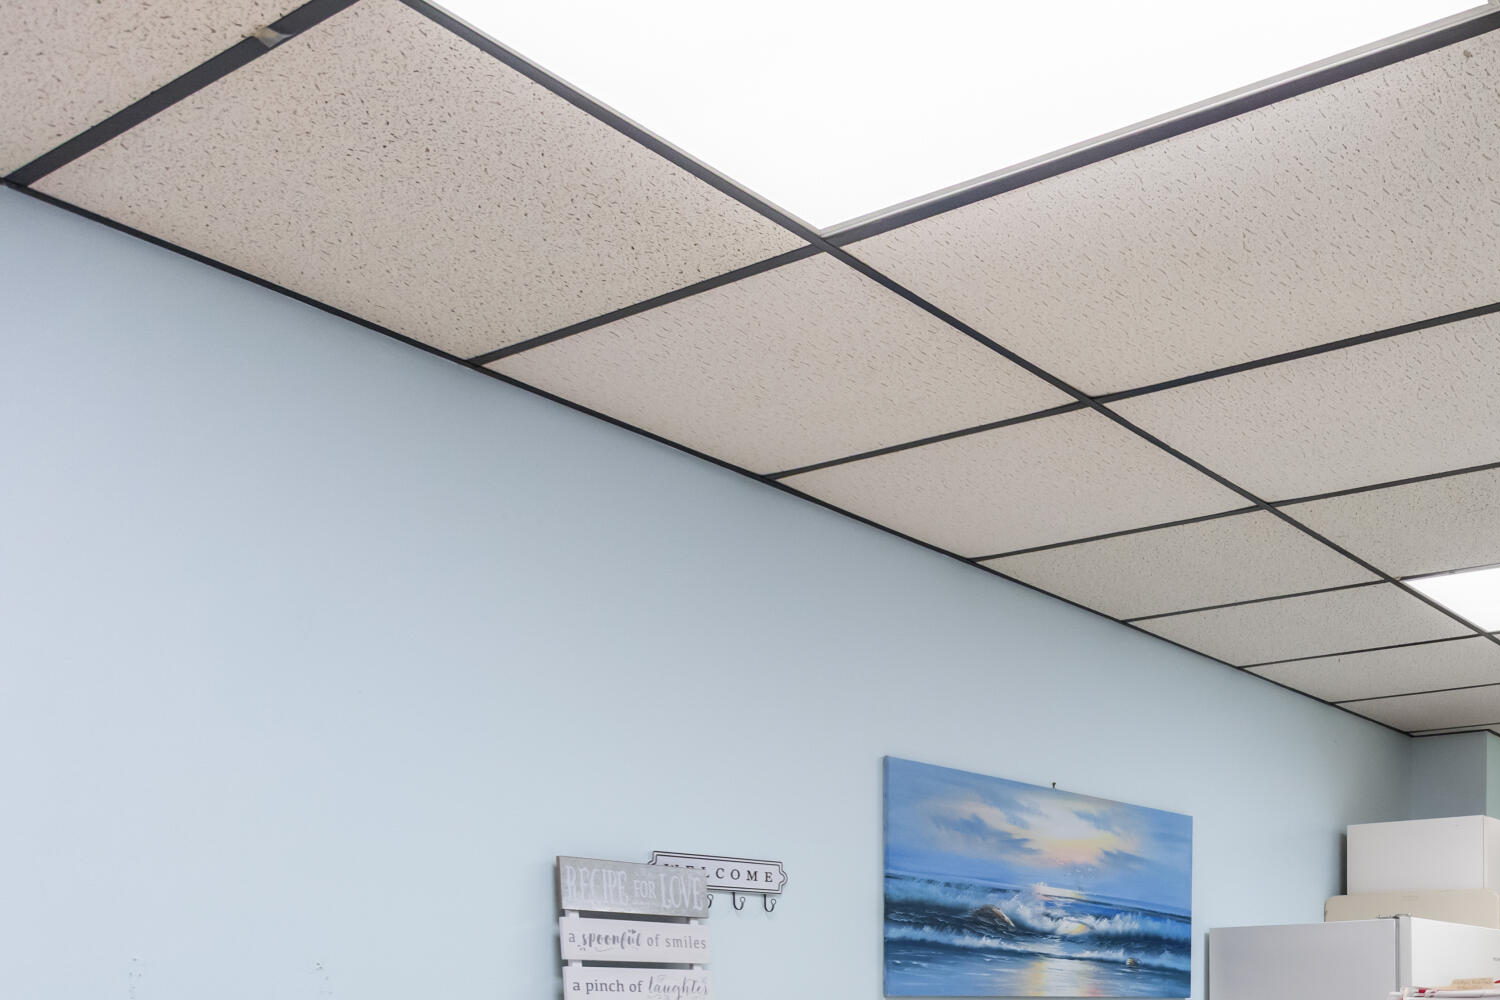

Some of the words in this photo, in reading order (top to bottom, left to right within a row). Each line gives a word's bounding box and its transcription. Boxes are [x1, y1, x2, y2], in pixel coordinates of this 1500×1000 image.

[664, 863, 774, 883] COME
[564, 865, 629, 904] RECIPE
[633, 879, 657, 899] FOR
[659, 873, 704, 911] LOVE
[568, 932, 576, 943] a
[582, 930, 641, 950] spoonful
[647, 934, 661, 947] of
[665, 934, 707, 950] smiles
[572, 981, 581, 991] a
[585, 979, 625, 994] pinch
[629, 980, 644, 992] of
